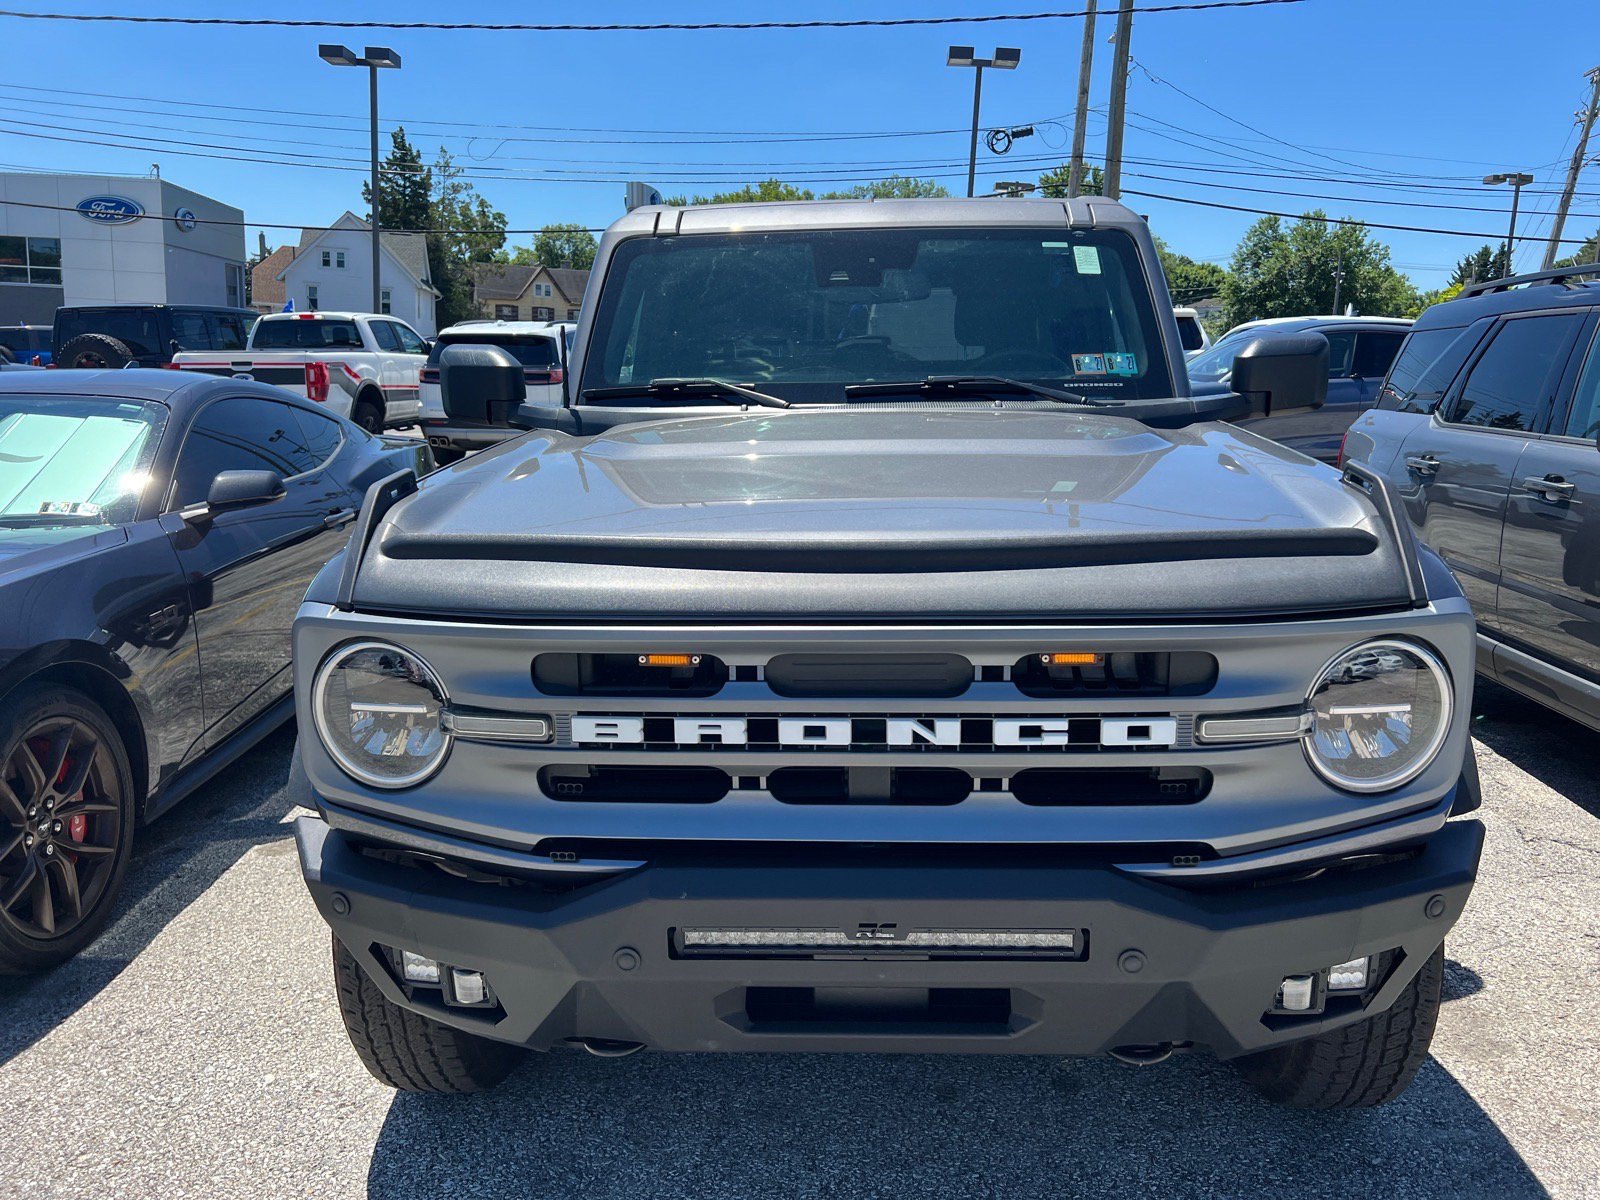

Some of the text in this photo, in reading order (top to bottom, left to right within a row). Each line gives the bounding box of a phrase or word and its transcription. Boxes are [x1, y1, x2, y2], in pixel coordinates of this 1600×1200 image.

[88, 201, 125, 218] Ford
[1075, 358, 1083, 371] 6
[1107, 357, 1115, 370] 6
[571, 715, 1177, 746] BRONCO
